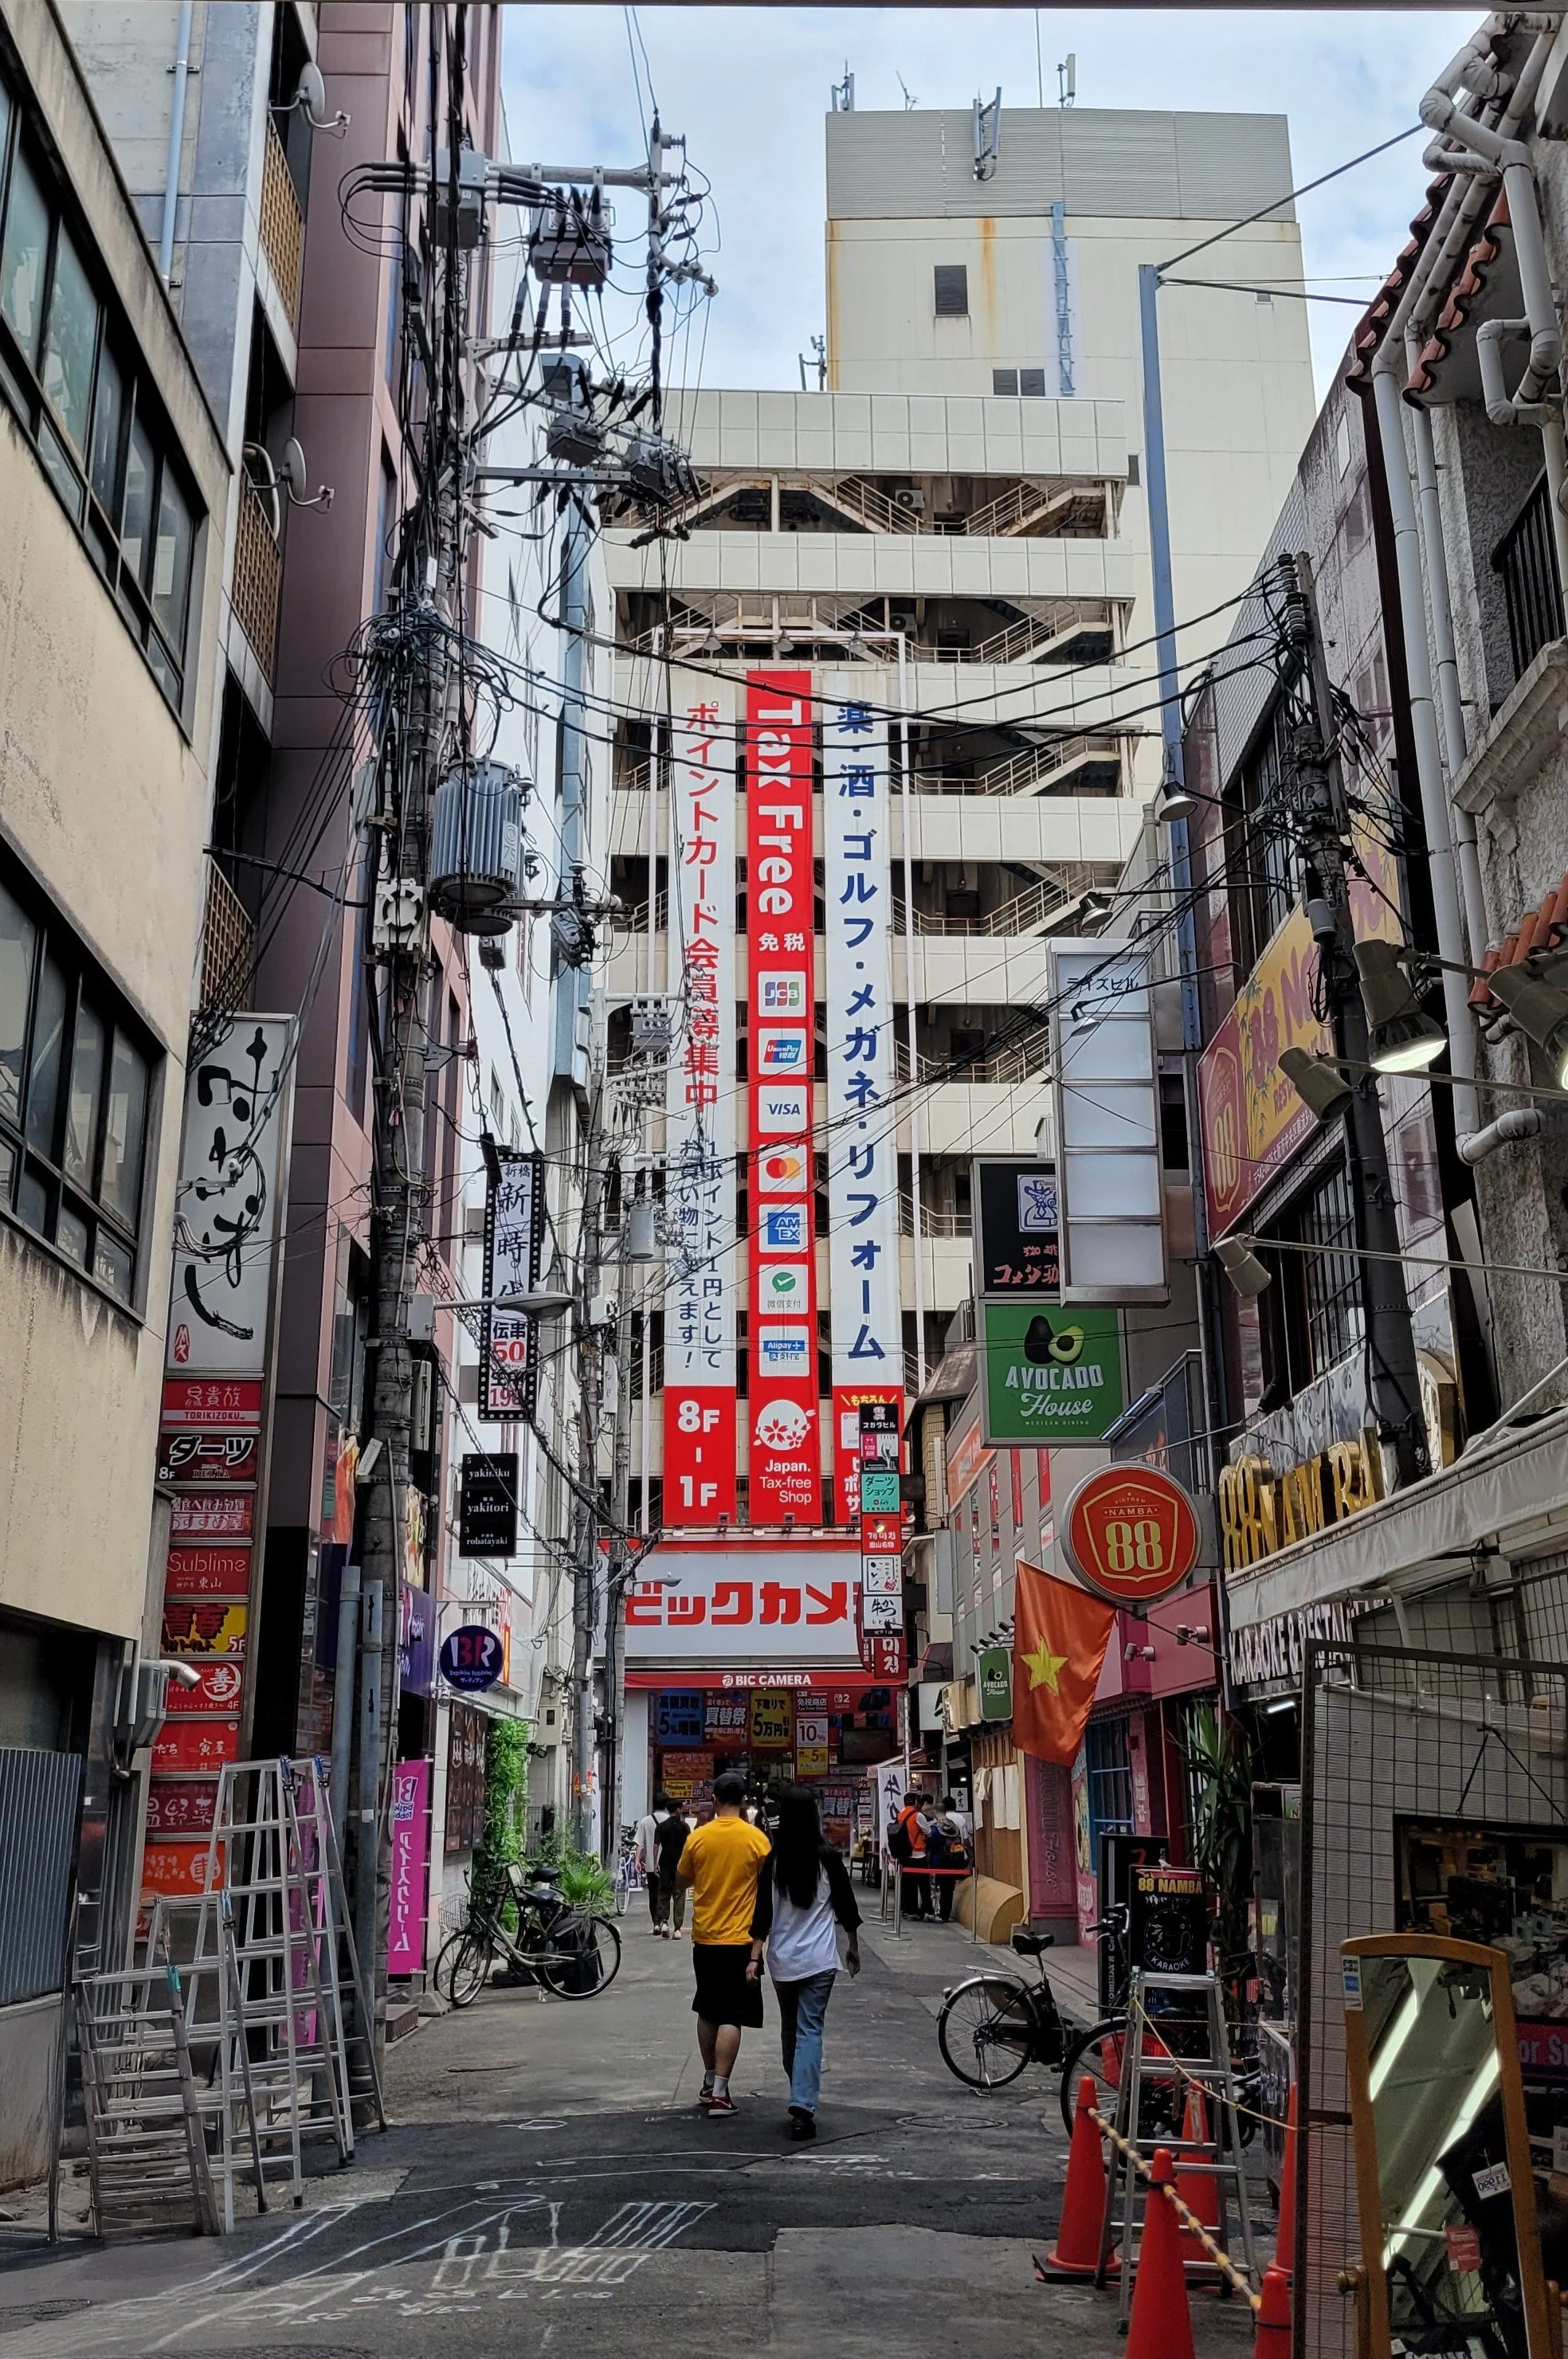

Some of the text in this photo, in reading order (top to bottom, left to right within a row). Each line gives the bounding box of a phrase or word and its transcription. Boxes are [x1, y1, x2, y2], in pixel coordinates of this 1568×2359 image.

[757, 700, 803, 915] Tax Free
[758, 932, 806, 952] 免税
[765, 1103, 802, 1115] VISA
[1005, 1364, 1104, 1390] AVOCADO
[184, 1385, 242, 1408] 鳥貴族
[1020, 1392, 1094, 1417] House
[184, 1410, 241, 1420] TORIKIZOKU
[678, 1400, 720, 1432] 8F
[168, 1435, 254, 1466] ダーツ
[159, 1466, 176, 1480] 8F
[764, 1460, 811, 1476] Japan.
[759, 1477, 813, 1490] Tax-free
[864, 1475, 895, 1487] ダーツ
[678, 1476, 718, 1507] 1F
[778, 1491, 813, 1505] Shop
[865, 1487, 896, 1497] ショップ
[467, 1502, 510, 1515] yakitori
[1105, 1520, 1163, 1572] 88
[169, 1552, 247, 1573] Sublime
[625, 1580, 862, 1626] ビックカメ
[204, 1667, 238, 1691] 善
[735, 1674, 812, 1687] BIC CAMERA
[227, 1700, 240, 1710] 4F
[1138, 1877, 1203, 1895] 88 NAMBA
[1150, 1956, 1191, 1972] KARAOKE
